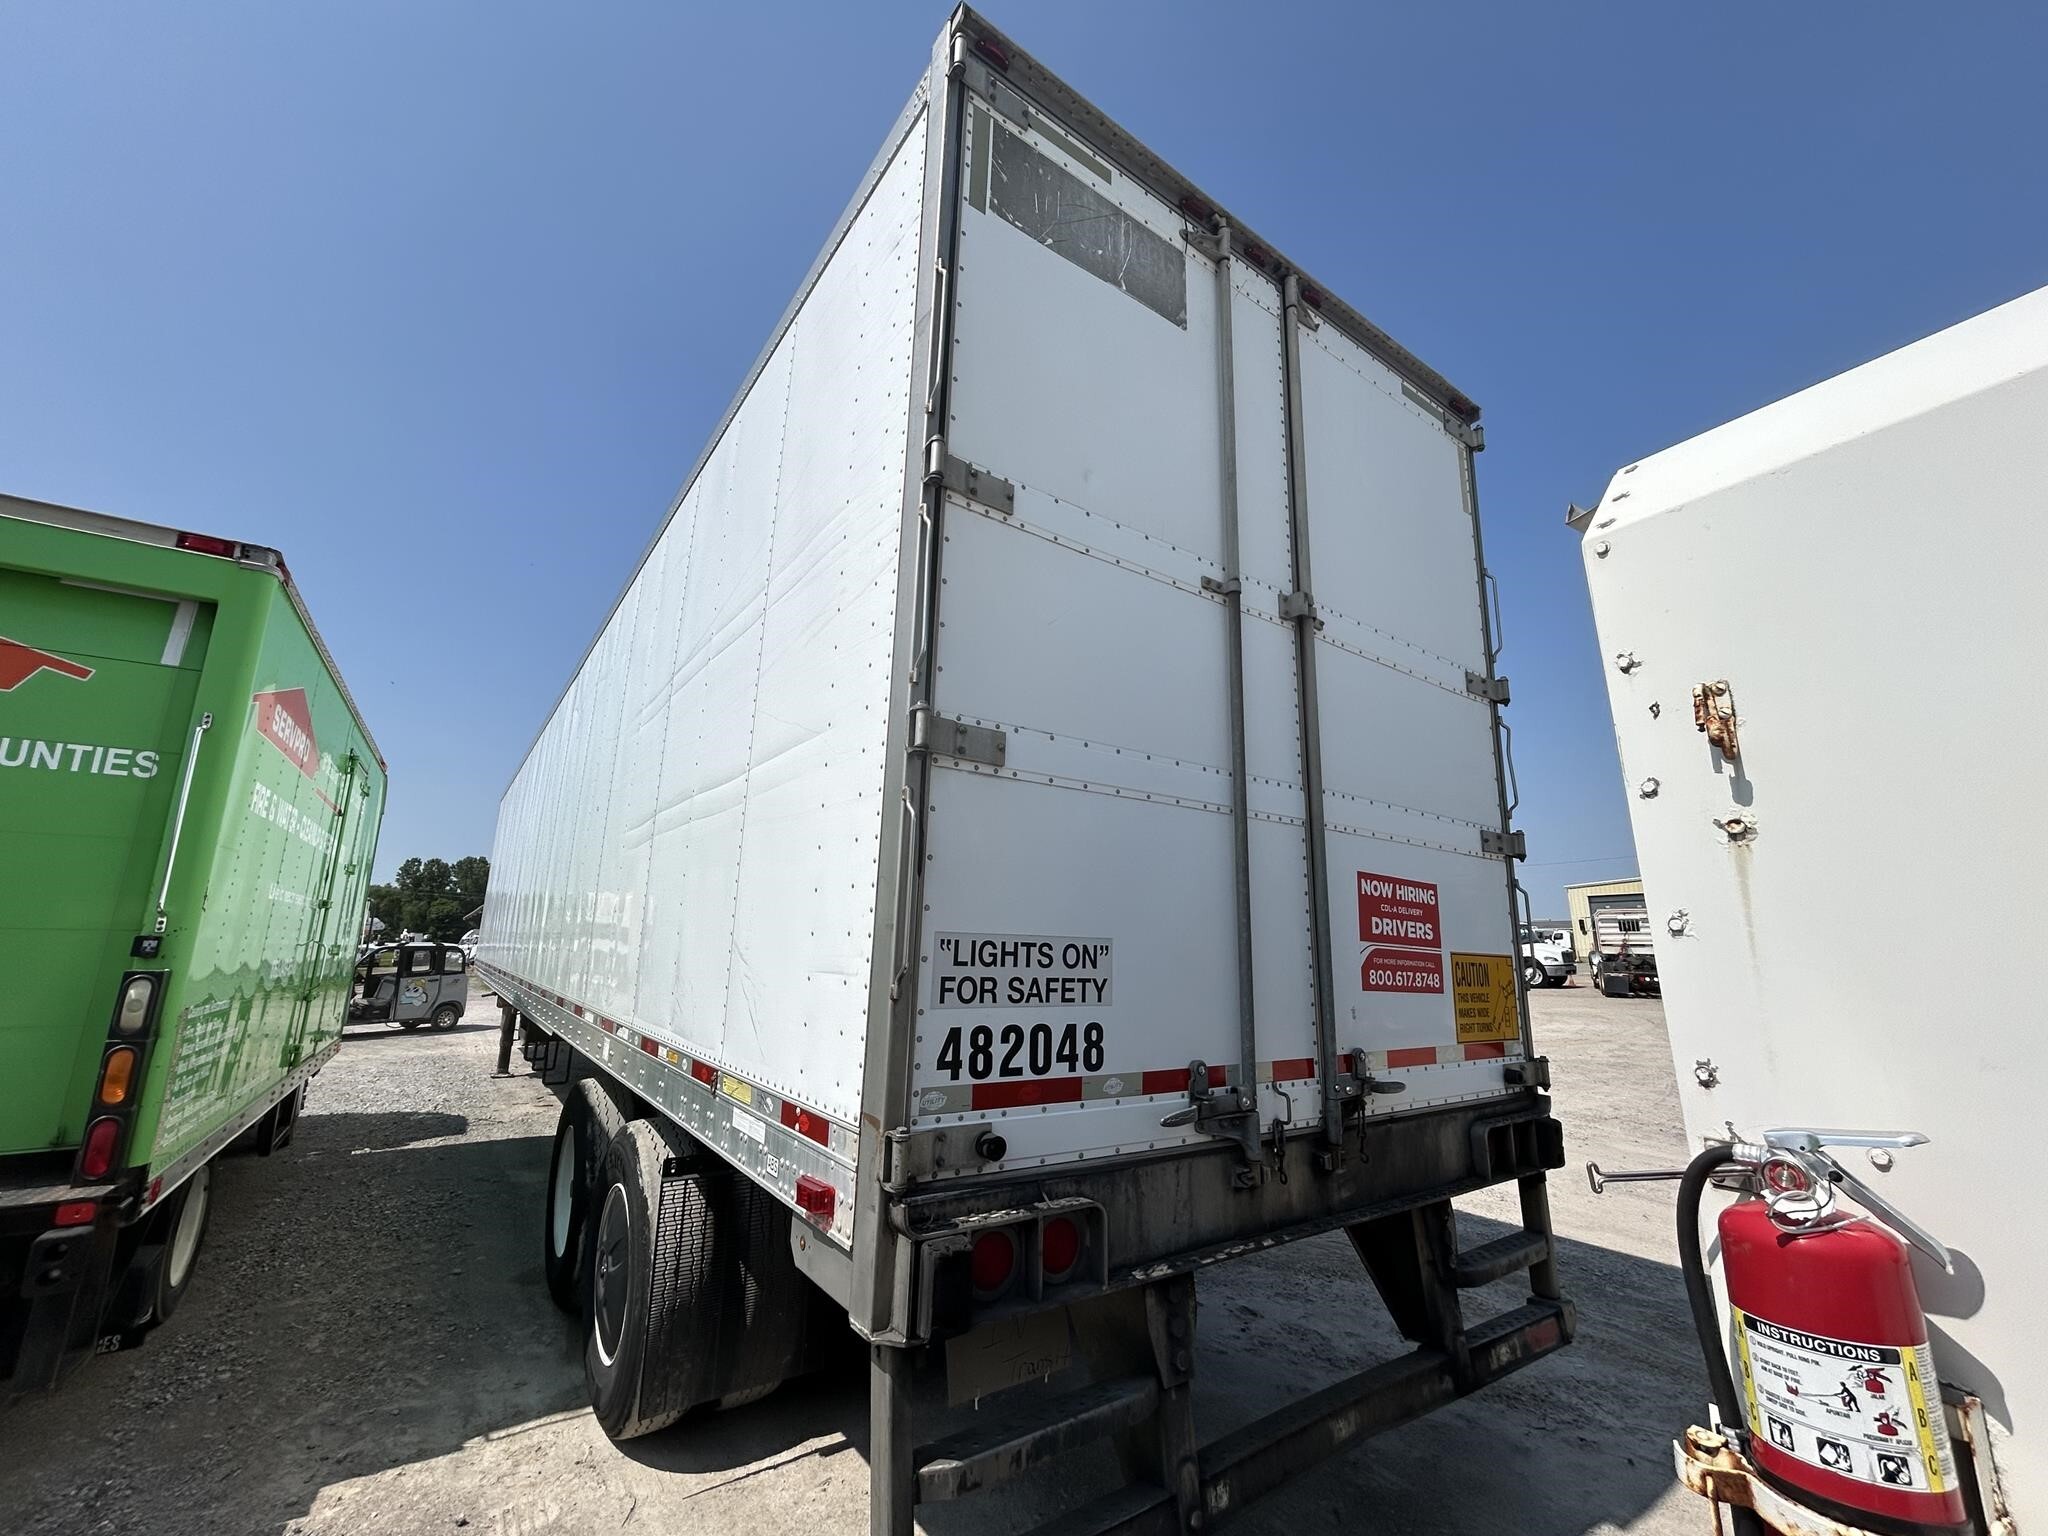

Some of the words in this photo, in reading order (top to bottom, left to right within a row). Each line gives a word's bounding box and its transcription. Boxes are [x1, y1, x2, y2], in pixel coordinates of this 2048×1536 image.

[272, 704, 311, 762] SERVPRO
[0, 737, 159, 778] UNTIES
[1361, 878, 1393, 899] NOW
[1396, 884, 1436, 905] HIRING
[1380, 904, 1398, 913] CDL-A
[1398, 906, 1423, 916] DELIVERY
[1371, 916, 1434, 940] DRIVERS
[940, 938, 1054, 969] "LIGHTS
[1062, 943, 1109, 970] ON"
[1369, 970, 1440, 988] 800.617.8748
[1455, 961, 1490, 987] CAUTION
[939, 976, 998, 1004] FOR
[1007, 976, 1108, 1004] SAFETY
[1457, 992, 1470, 1003] THIS
[1470, 992, 1490, 1003] VEHICLE
[1458, 1007, 1476, 1018] MAKES
[1460, 1022, 1475, 1033] RIGHT
[936, 1022, 1104, 1081] 482048
[768, 1157, 778, 1174] ABS
[1757, 1321, 1881, 1361] INSTRUCTIONS
[1909, 1362, 1918, 1381] A
[1918, 1408, 1927, 1428] B
[1929, 1455, 1937, 1476] C
